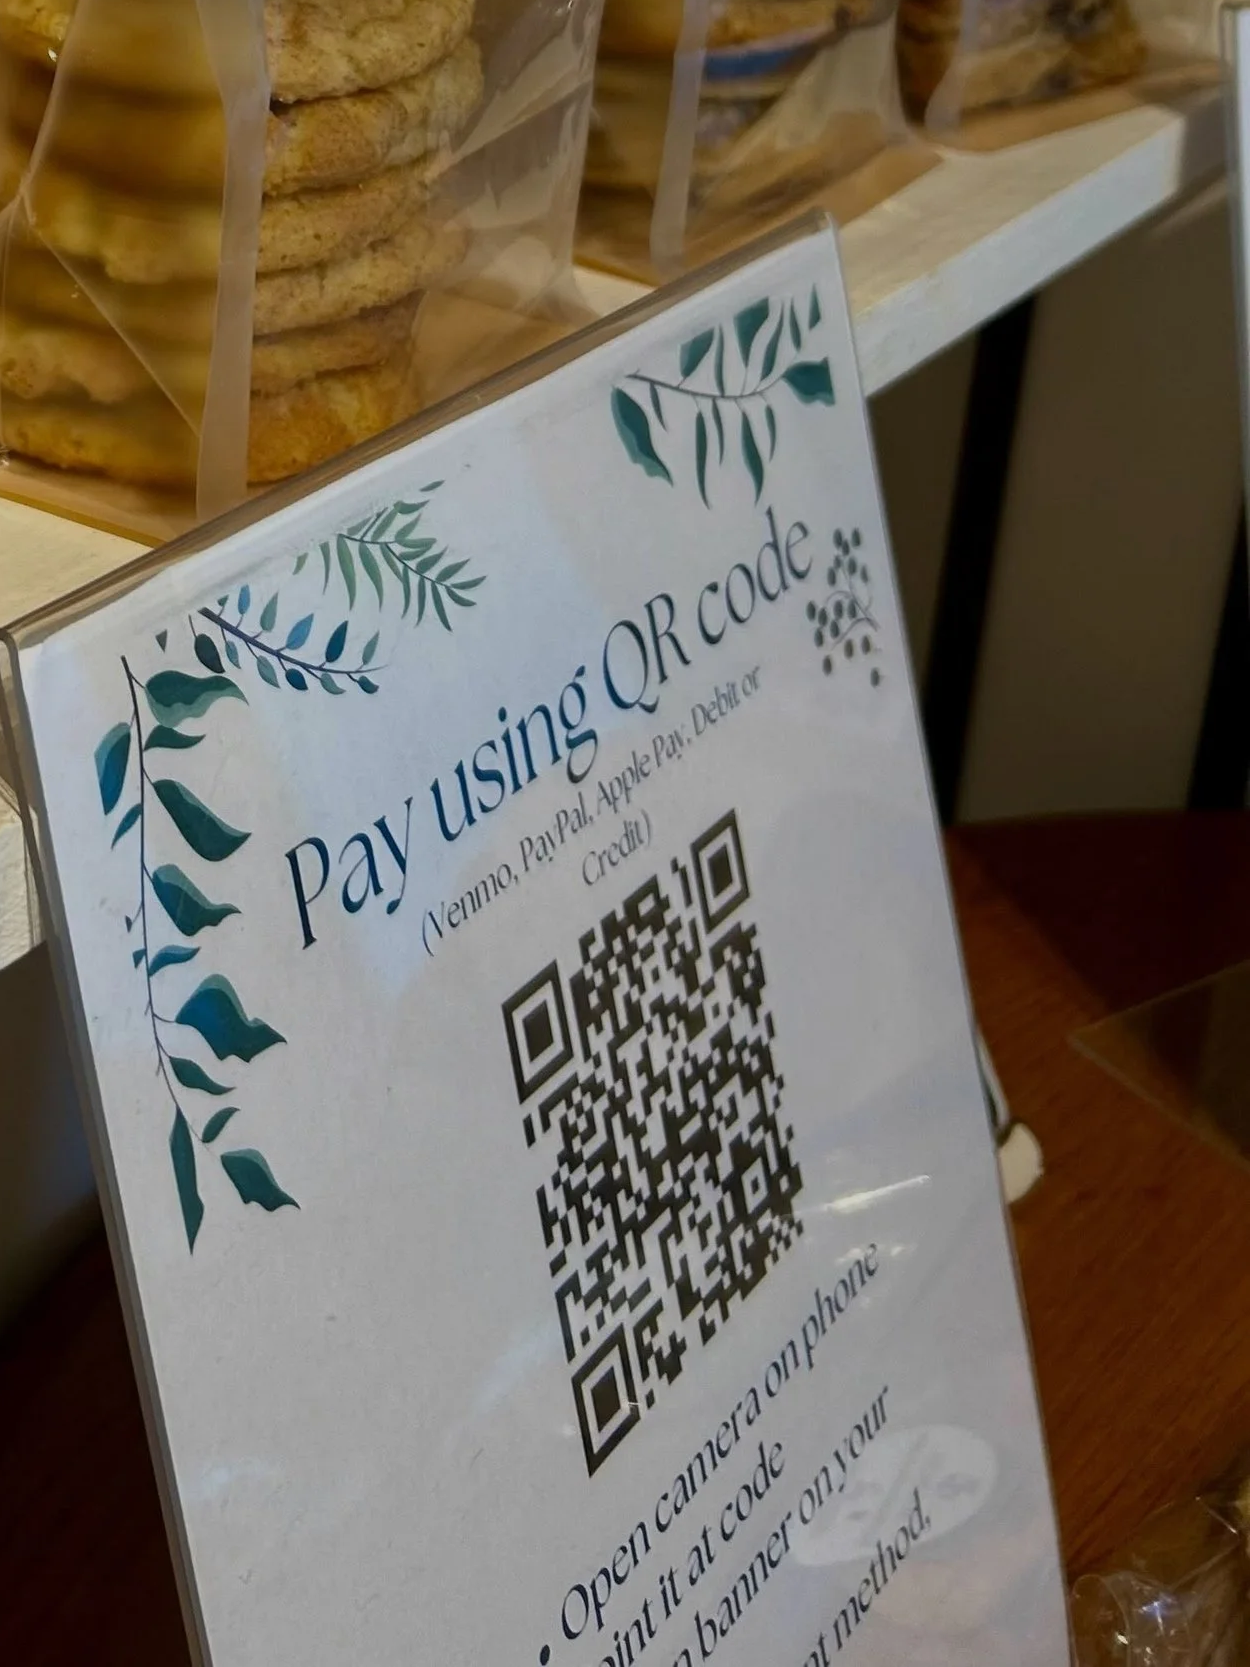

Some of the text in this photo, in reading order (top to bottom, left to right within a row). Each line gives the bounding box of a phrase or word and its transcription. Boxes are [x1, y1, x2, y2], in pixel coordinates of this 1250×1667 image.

[284, 505, 813, 952] Pay using QR code
[421, 860, 521, 958] (Venmo,
[519, 790, 595, 873] PayPal,
[596, 748, 652, 818] Apple
[690, 680, 741, 738] Debit
[741, 664, 763, 689] or
[582, 807, 654, 888] Credit)
[560, 1242, 881, 1641] Open camera on phone
[658, 1566, 685, 1620] it
[687, 1524, 718, 1587] at
[719, 1439, 787, 1542] code
[694, 1511, 793, 1663] banner
[798, 1464, 836, 1526] on
[834, 1384, 891, 1494] your
[831, 1485, 934, 1652] method,
